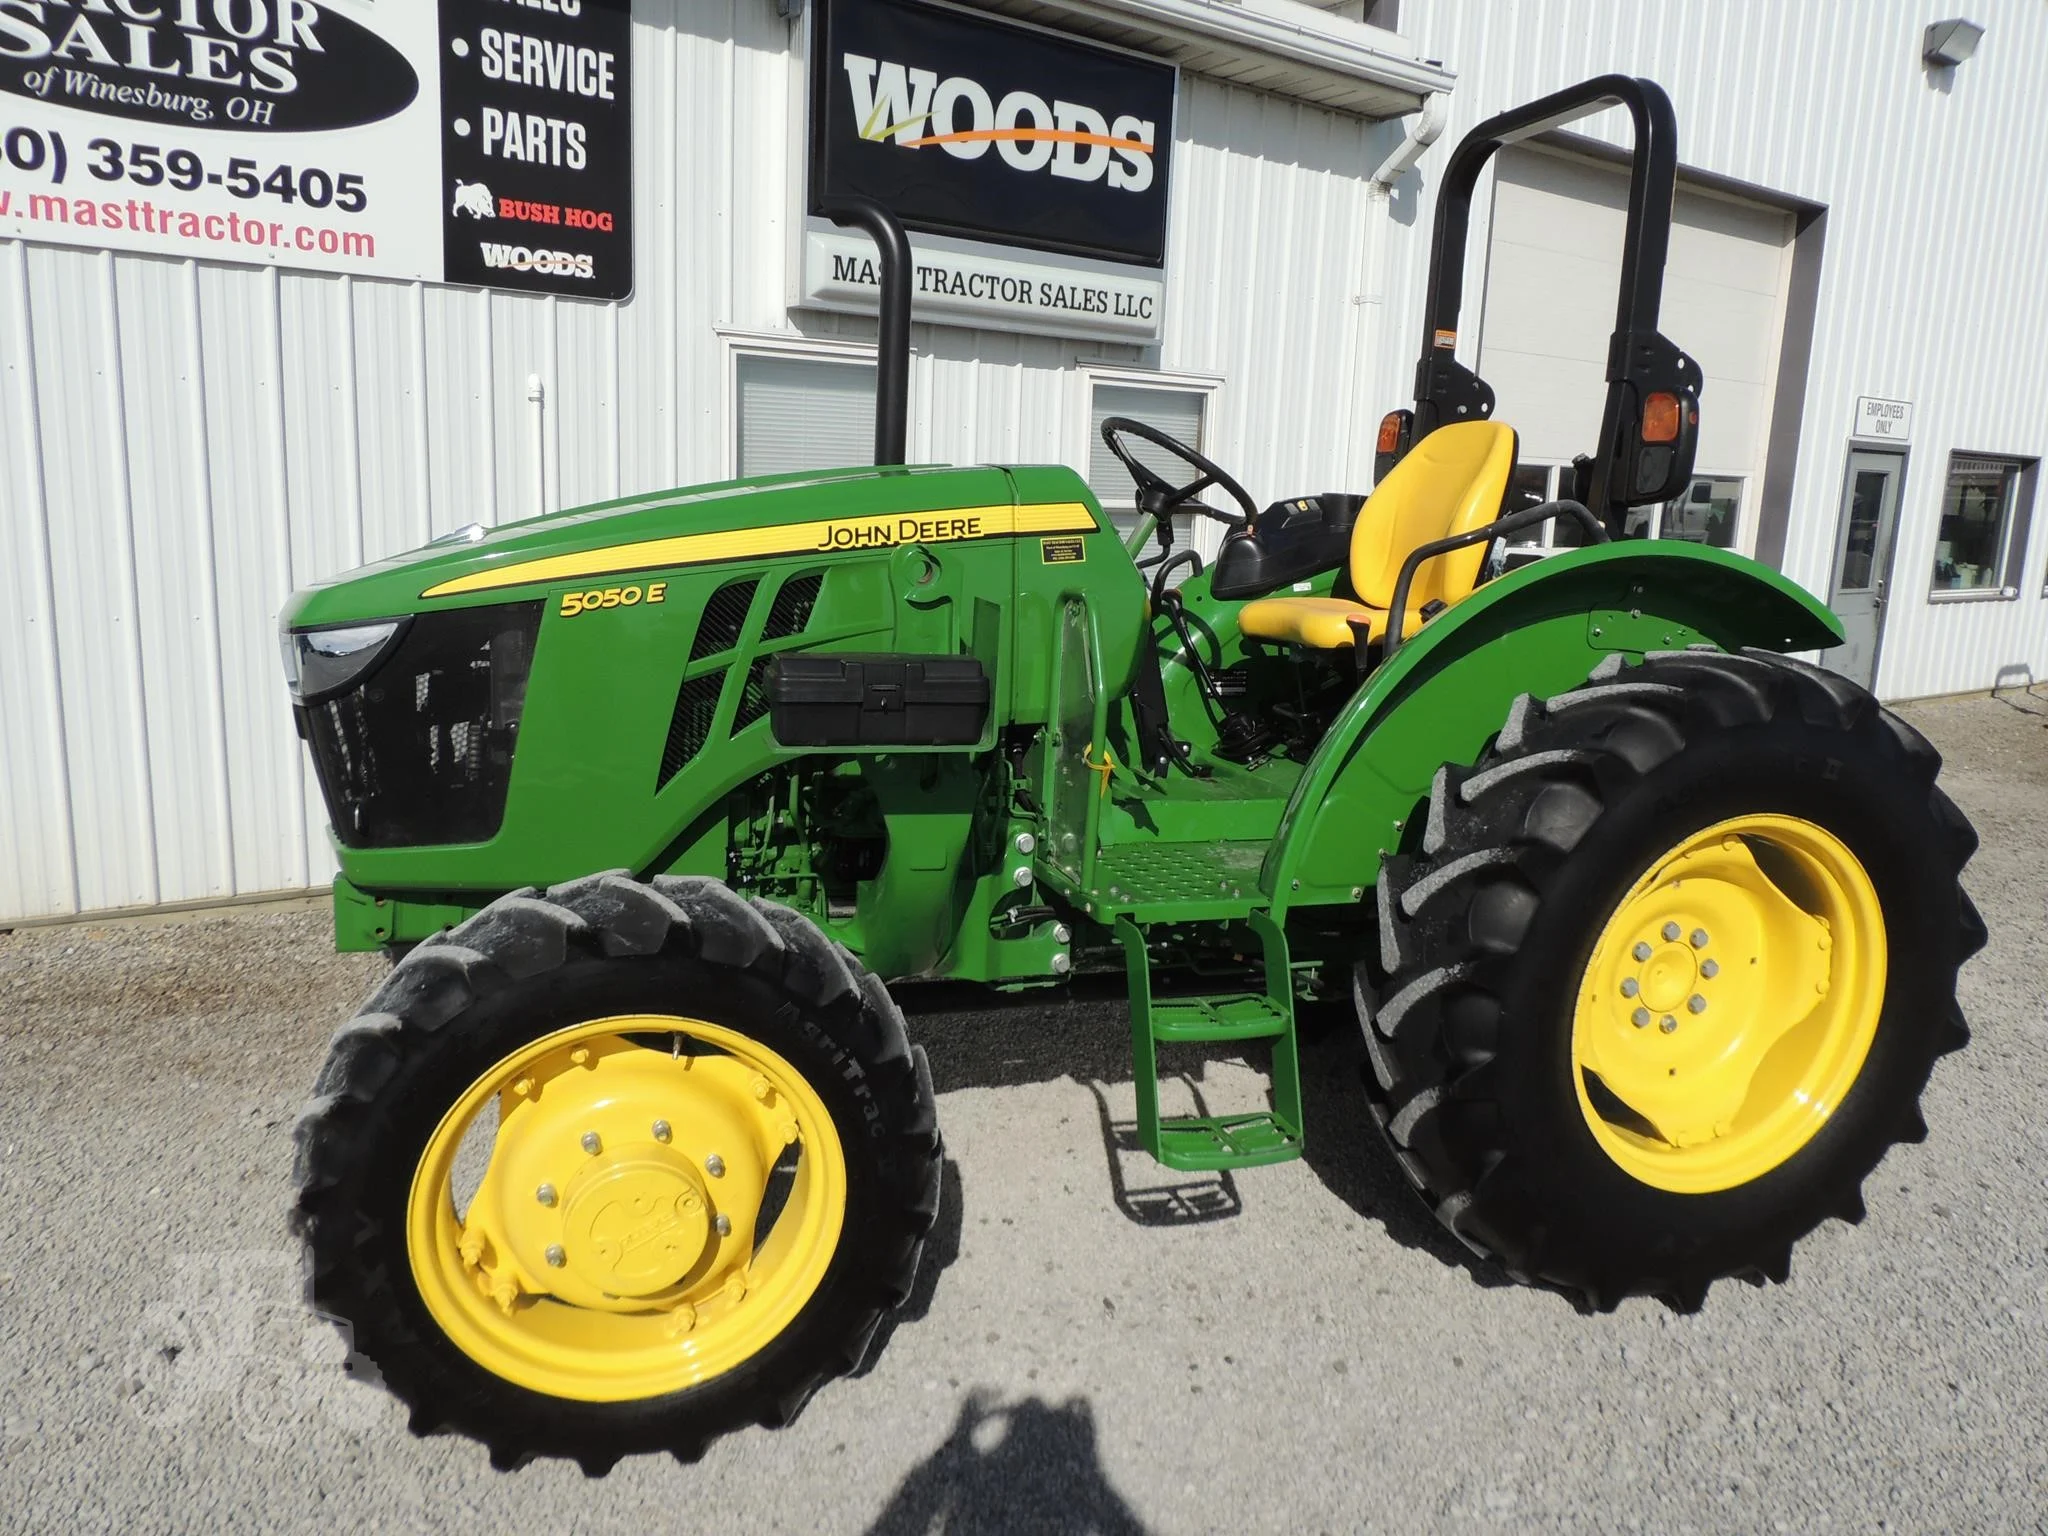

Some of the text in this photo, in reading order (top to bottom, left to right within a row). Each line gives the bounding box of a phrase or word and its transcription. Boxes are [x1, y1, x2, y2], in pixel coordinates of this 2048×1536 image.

[480, 27, 615, 100] SERVICE
[23, 66, 275, 126] of Winesburg, OH
[482, 106, 587, 170] PARTS
[844, 53, 1155, 192] WOODS
[87, 138, 368, 213] 359-5405
[499, 198, 613, 232] BUSH HOG
[480, 242, 594, 279] WOODS
[917, 266, 1033, 304] TRACTOR
[1039, 283, 1109, 314] SALES
[1113, 293, 1153, 319] LLC
[1866, 402, 1904, 419] EMPLOYEES
[1875, 419, 1893, 434] ONLY
[818, 517, 982, 548] JOHN DEERE
[560, 583, 668, 617] 5050 E
